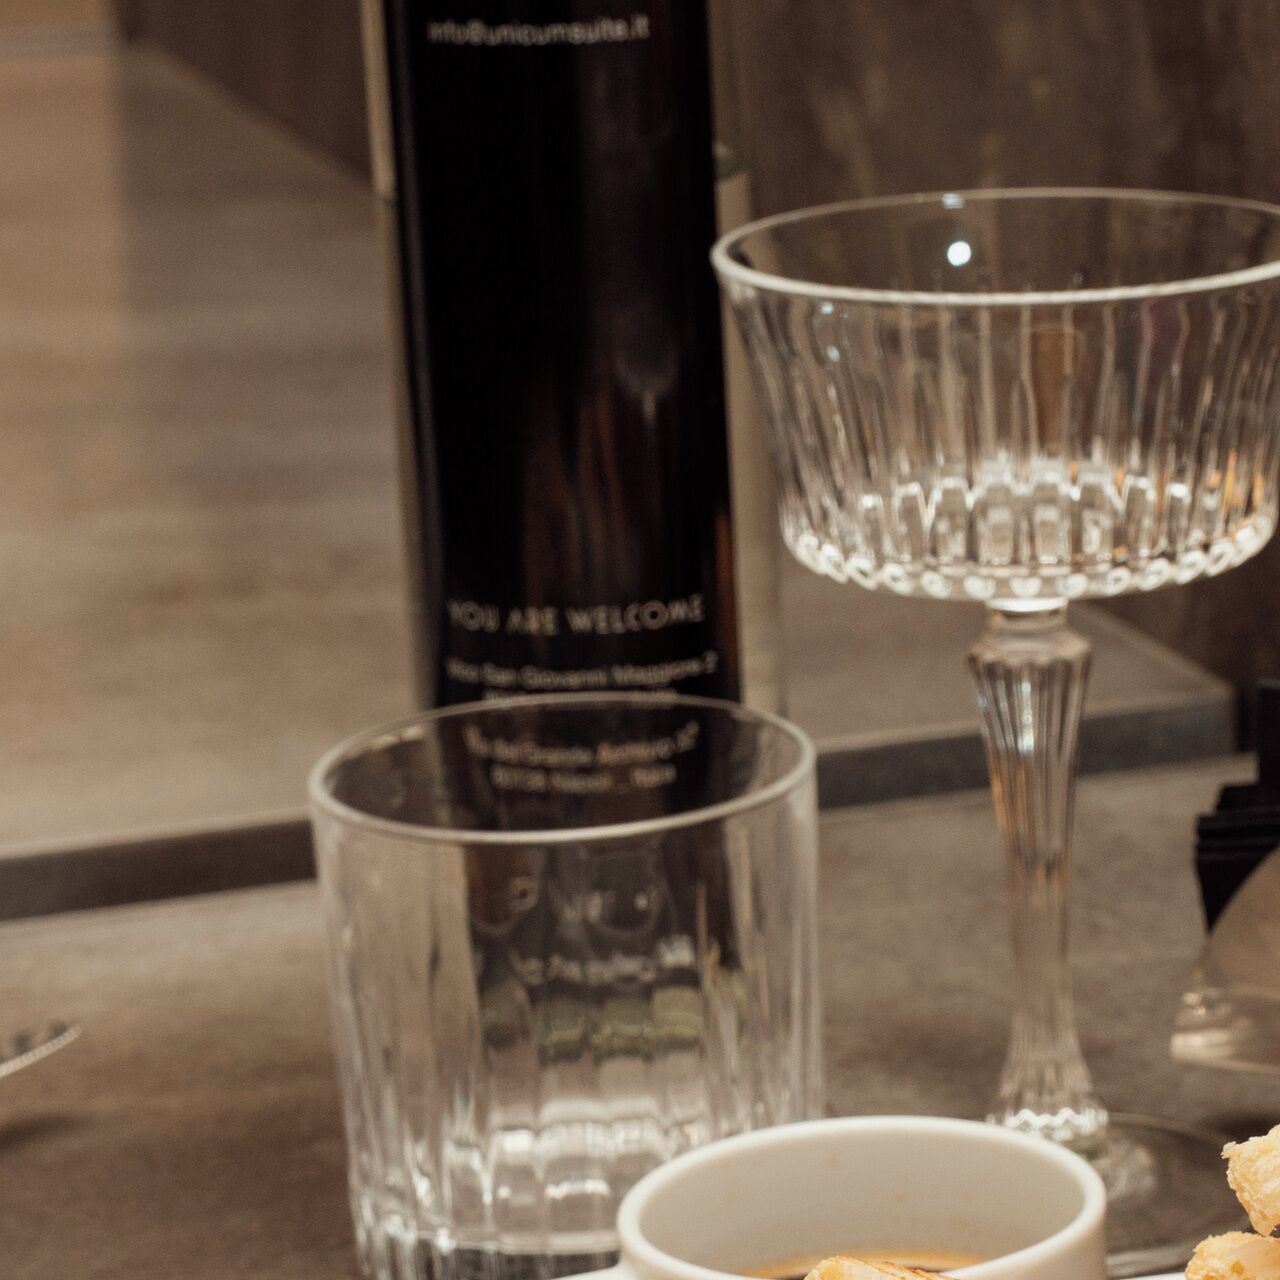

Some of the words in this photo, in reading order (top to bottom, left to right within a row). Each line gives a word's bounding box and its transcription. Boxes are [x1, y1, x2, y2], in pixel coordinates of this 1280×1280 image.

[427, 14, 650, 47] info@unicumsuite.it
[448, 598, 500, 632] YOU
[506, 606, 559, 636] ARE
[565, 593, 704, 634] WELCOME
